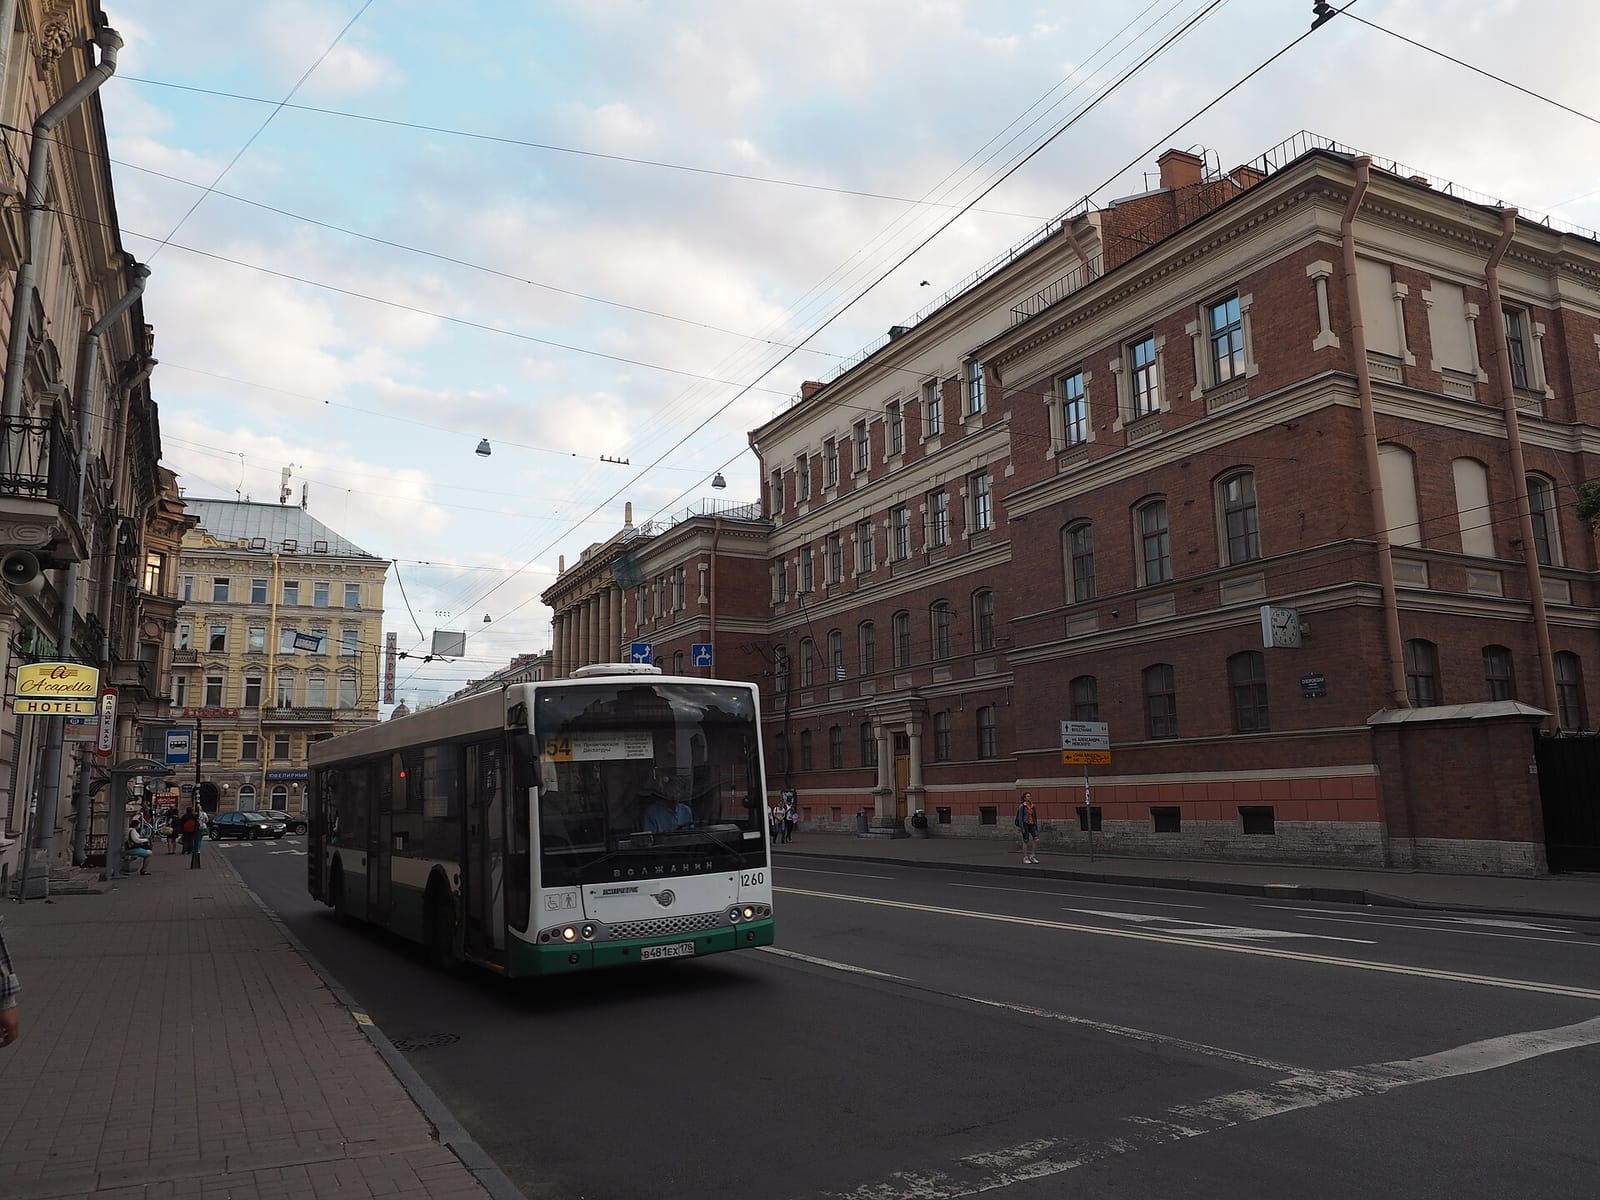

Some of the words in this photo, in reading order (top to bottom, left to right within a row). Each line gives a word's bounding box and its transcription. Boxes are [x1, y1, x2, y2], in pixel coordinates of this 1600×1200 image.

[28, 702, 82, 713] HOTEL
[547, 738, 571, 756] 54
[268, 771, 308, 779] ЮВЕЛИРНЫЙ
[613, 860, 713, 878] ВОЛЖАНИН
[740, 872, 764, 888] 1260
